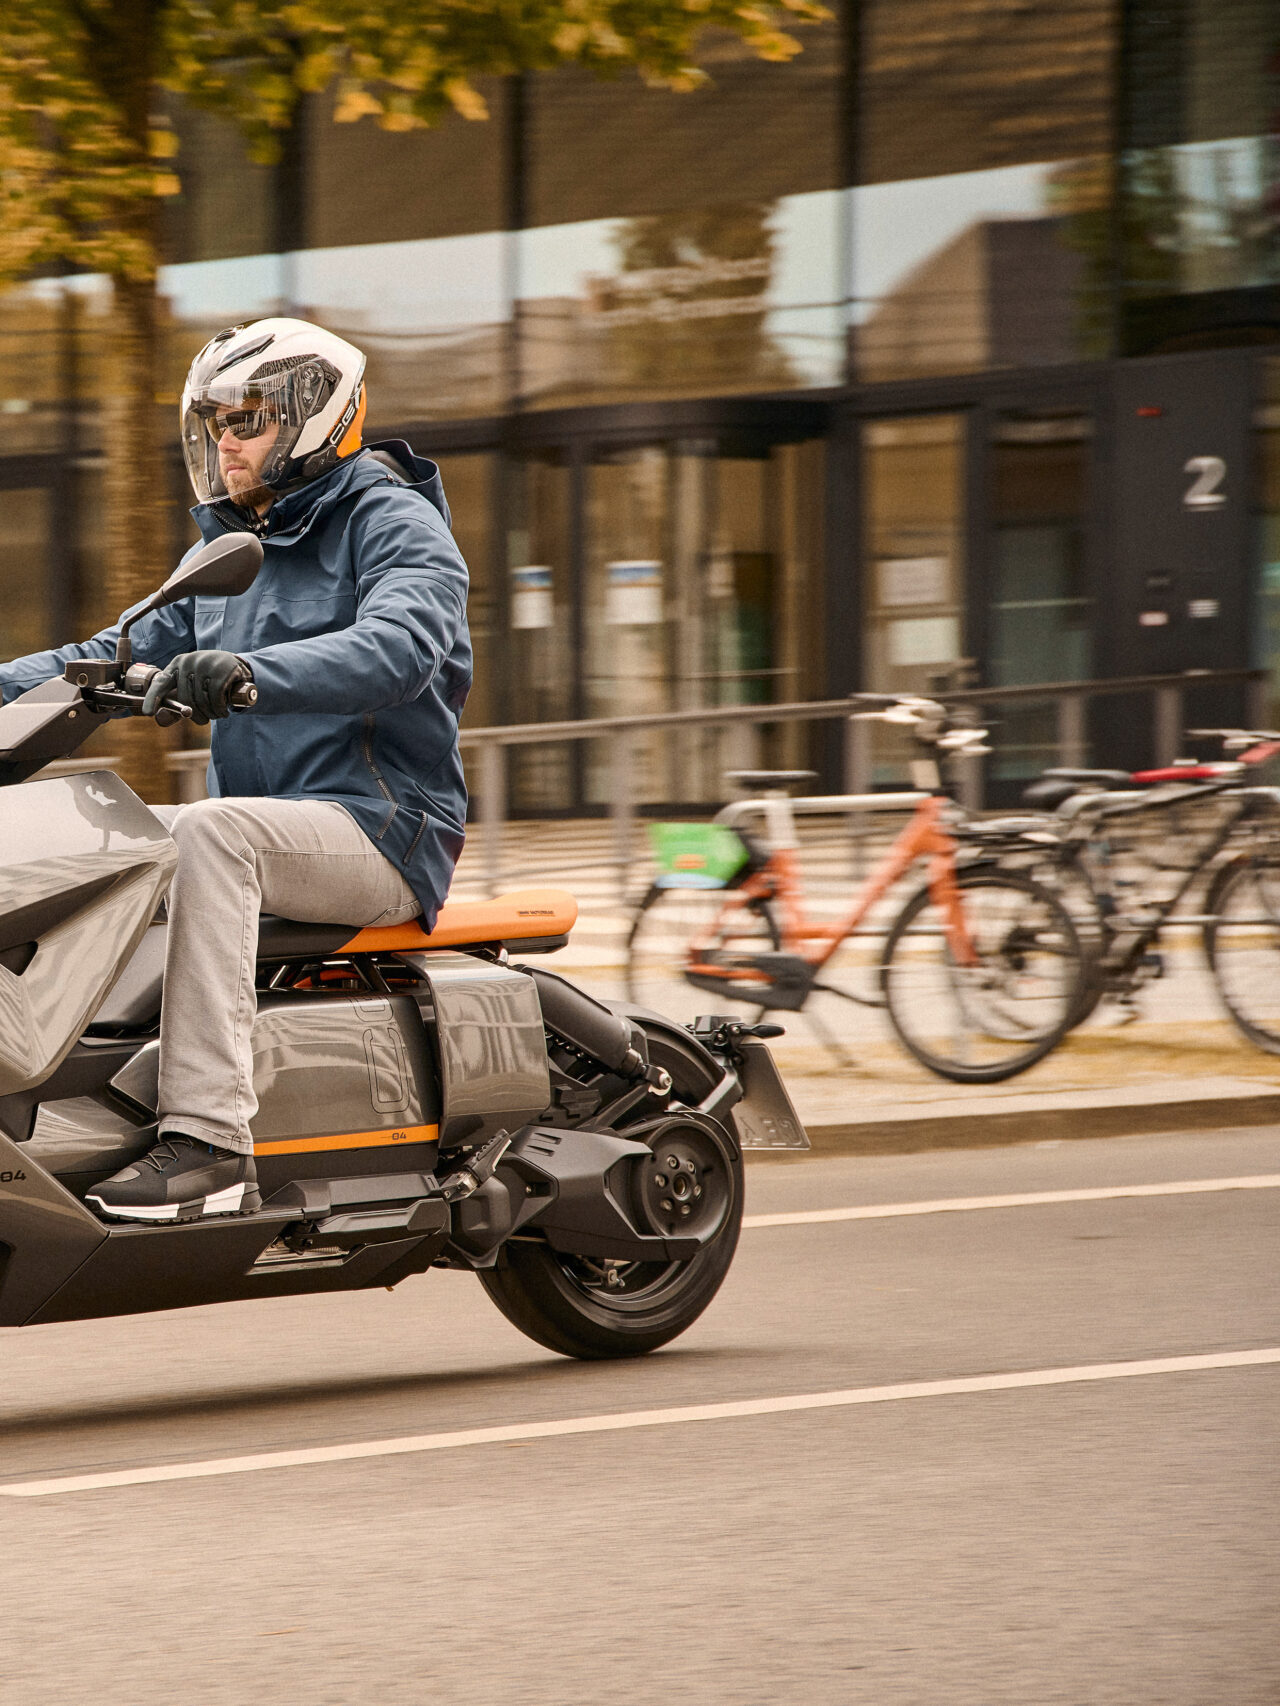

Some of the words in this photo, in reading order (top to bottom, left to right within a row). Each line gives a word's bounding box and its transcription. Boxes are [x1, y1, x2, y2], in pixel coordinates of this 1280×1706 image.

[1183, 455, 1227, 507] 2
[392, 1132, 407, 1140] 04
[0, 1169, 27, 1183] 04
